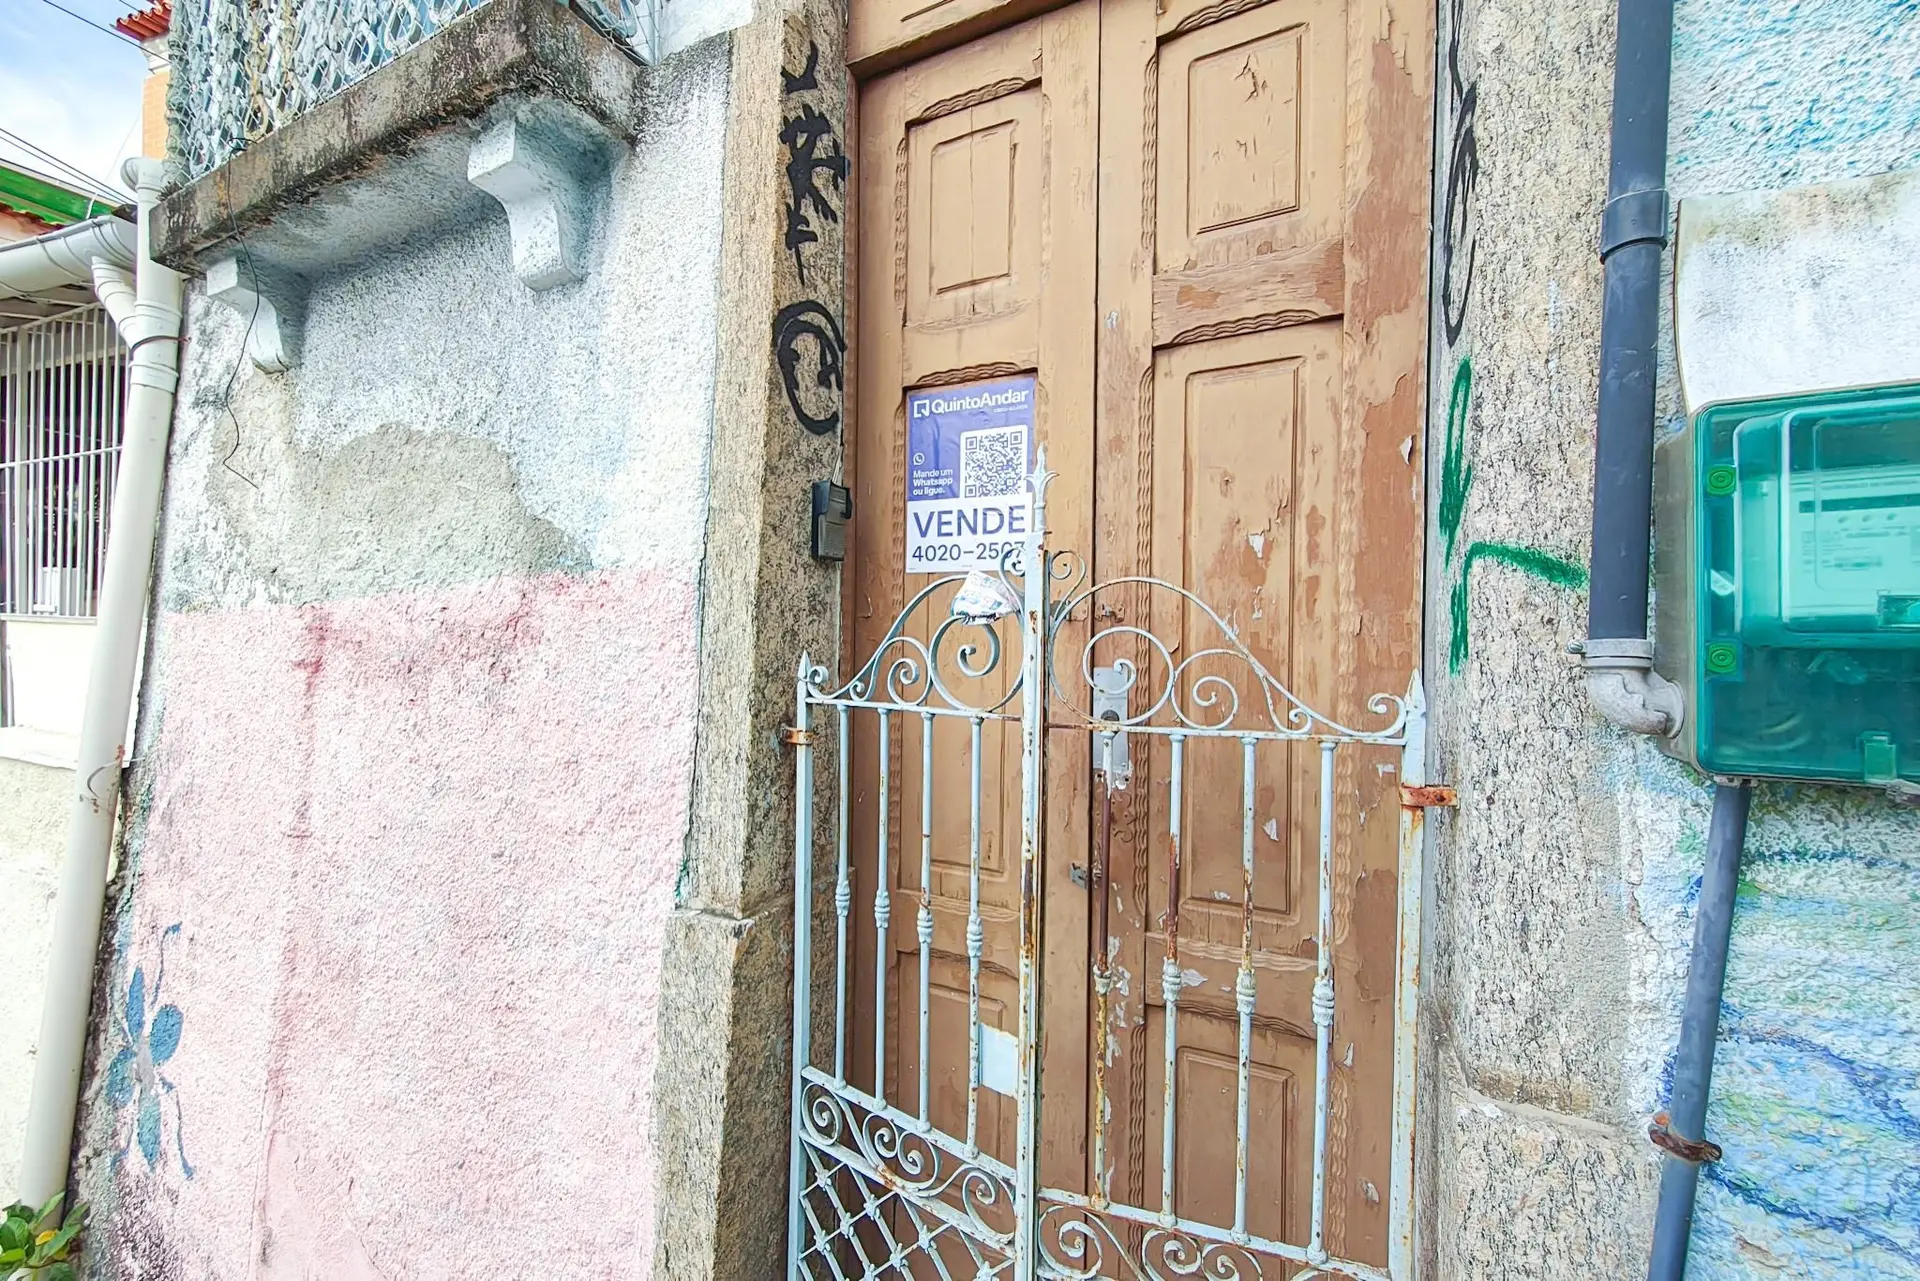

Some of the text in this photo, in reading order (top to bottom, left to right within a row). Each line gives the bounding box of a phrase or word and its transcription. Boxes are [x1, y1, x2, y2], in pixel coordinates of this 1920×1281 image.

[931, 389, 1029, 415] QuintoAndar
[913, 470, 939, 479] Mande
[913, 477, 953, 487] Whatsapp
[913, 486, 946, 496] ou ligue.
[913, 505, 1026, 538] VENDE
